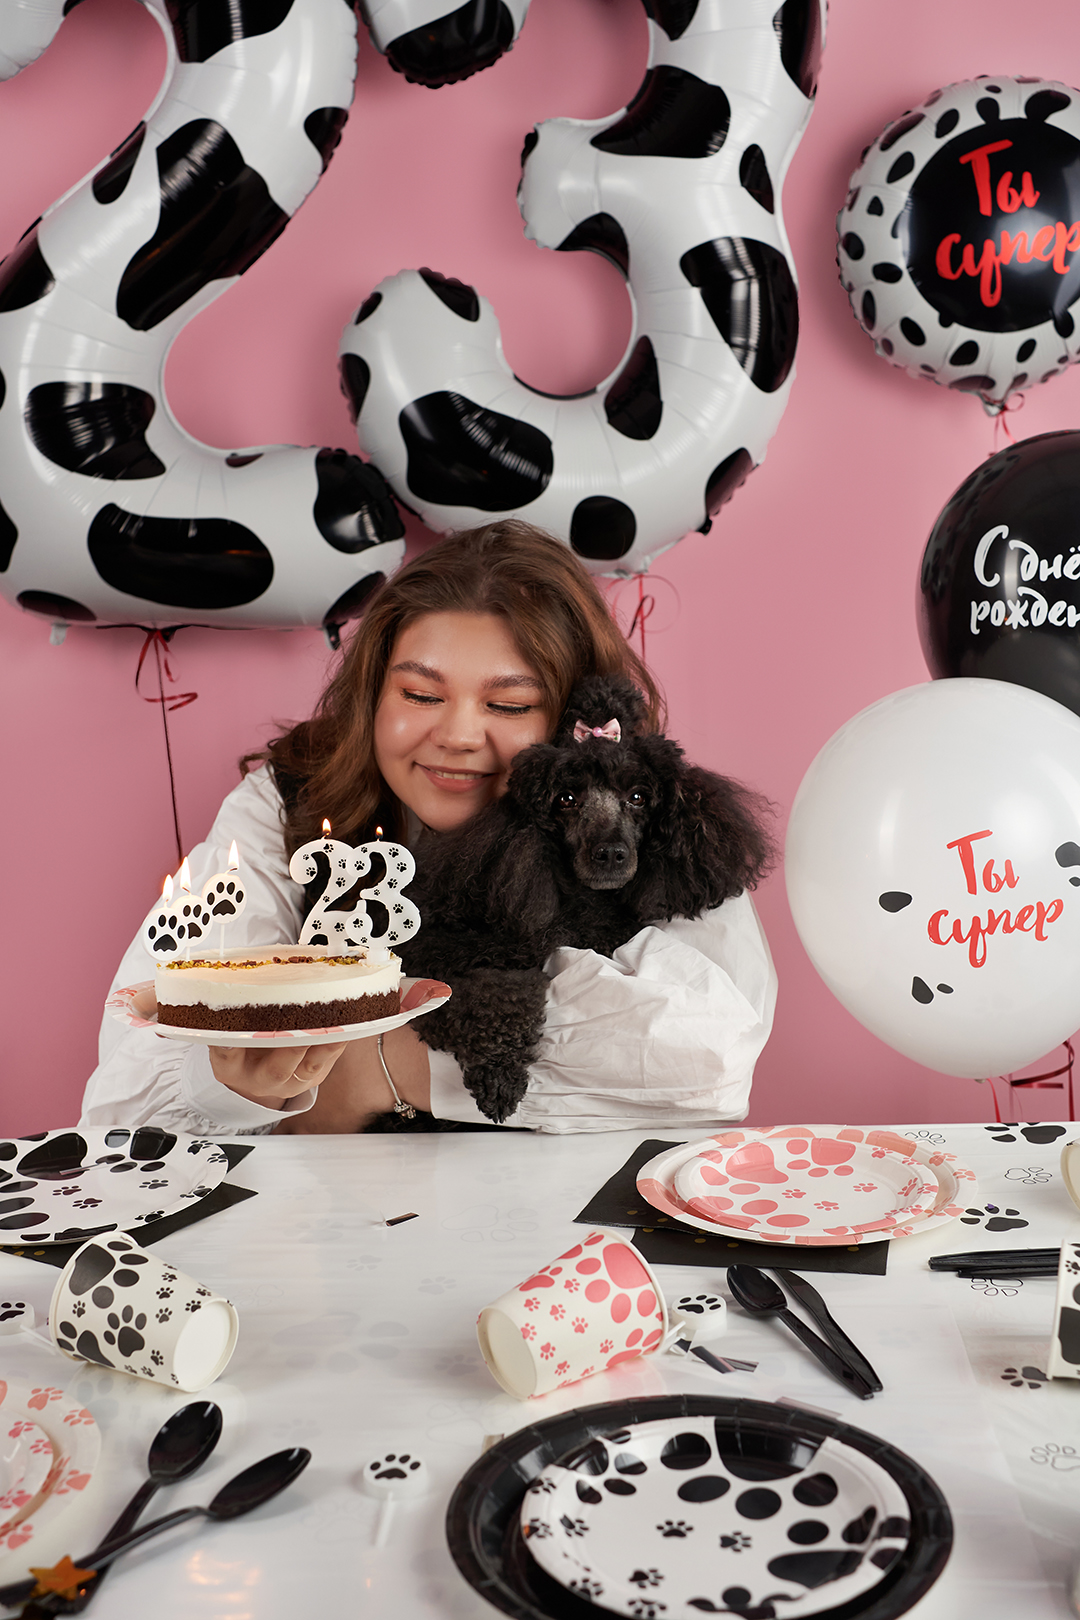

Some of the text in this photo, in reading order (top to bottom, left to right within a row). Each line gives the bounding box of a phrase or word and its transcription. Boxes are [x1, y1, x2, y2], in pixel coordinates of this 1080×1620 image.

[959, 139, 1041, 217] Ты
[935, 221, 1080, 307] супер
[974, 524, 1010, 588] С
[946, 829, 1020, 896] Ты
[927, 898, 1064, 968] супер
